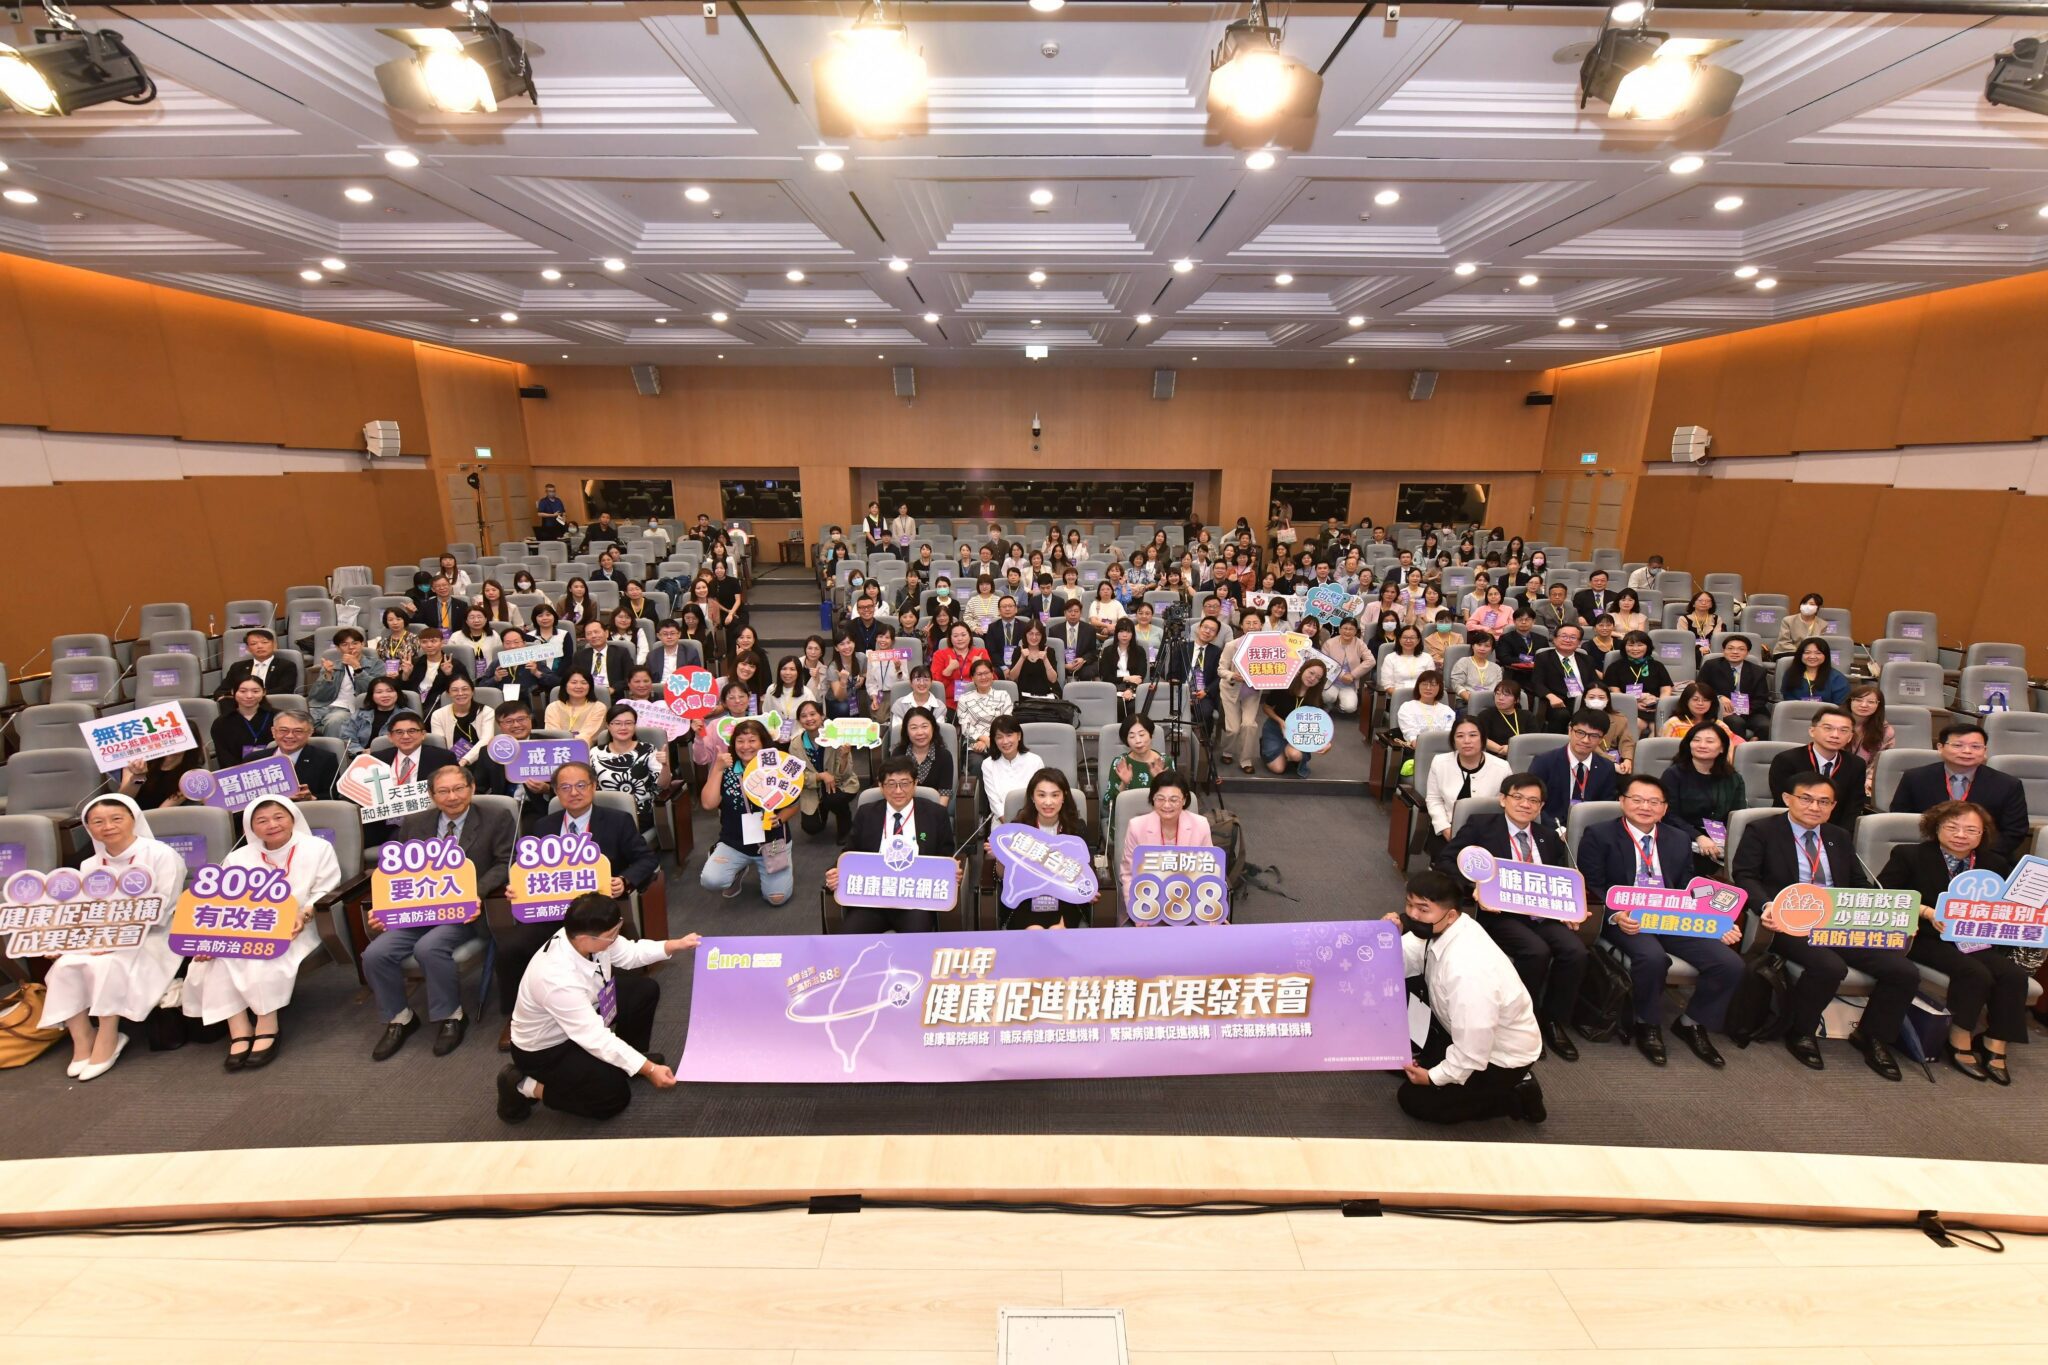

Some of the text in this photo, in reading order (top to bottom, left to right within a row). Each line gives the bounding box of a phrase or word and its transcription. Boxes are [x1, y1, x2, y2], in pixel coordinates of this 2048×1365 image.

[1249, 647, 1286, 660] 我新北
[1249, 662, 1287, 676] 我驕傲
[91, 711, 181, 747] 無菸1+1
[1295, 713, 1322, 721] 新北市
[1298, 722, 1320, 733] 都是
[527, 747, 572, 765] 戒菸
[218, 764, 285, 796] 腎臟病
[380, 839, 463, 872] 80%
[519, 835, 598, 866] 80%
[1142, 850, 1216, 873] 三高防治
[193, 866, 288, 901] 80%
[390, 875, 463, 902] 要介入
[527, 869, 597, 896] 找得出
[846, 874, 950, 900] 健康醫院網絡
[1499, 867, 1574, 899] 糖尿病
[1132, 880, 1224, 922] 888
[1499, 891, 1577, 913] 健康促進機構
[1613, 891, 1699, 910] 相揪量血壓
[1836, 892, 1913, 909] 均衡飲食
[0, 898, 162, 930] 健康促進機構
[193, 904, 277, 932] 有改善
[385, 906, 466, 925] 三高防治888
[1640, 912, 1718, 934] 健康888
[1834, 910, 1910, 927] 少鹽少油
[13, 924, 144, 953] 成果發表會
[181, 938, 276, 957] 三高防治888
[1811, 929, 1905, 948] 預防慢性病
[933, 948, 995, 977] 114年
[923, 975, 1311, 1026] 健康促進機構成果發表會
[923, 1029, 991, 1048] 健康醫院網絡
[1000, 1026, 1101, 1045] 糖尿病健康促進機構
